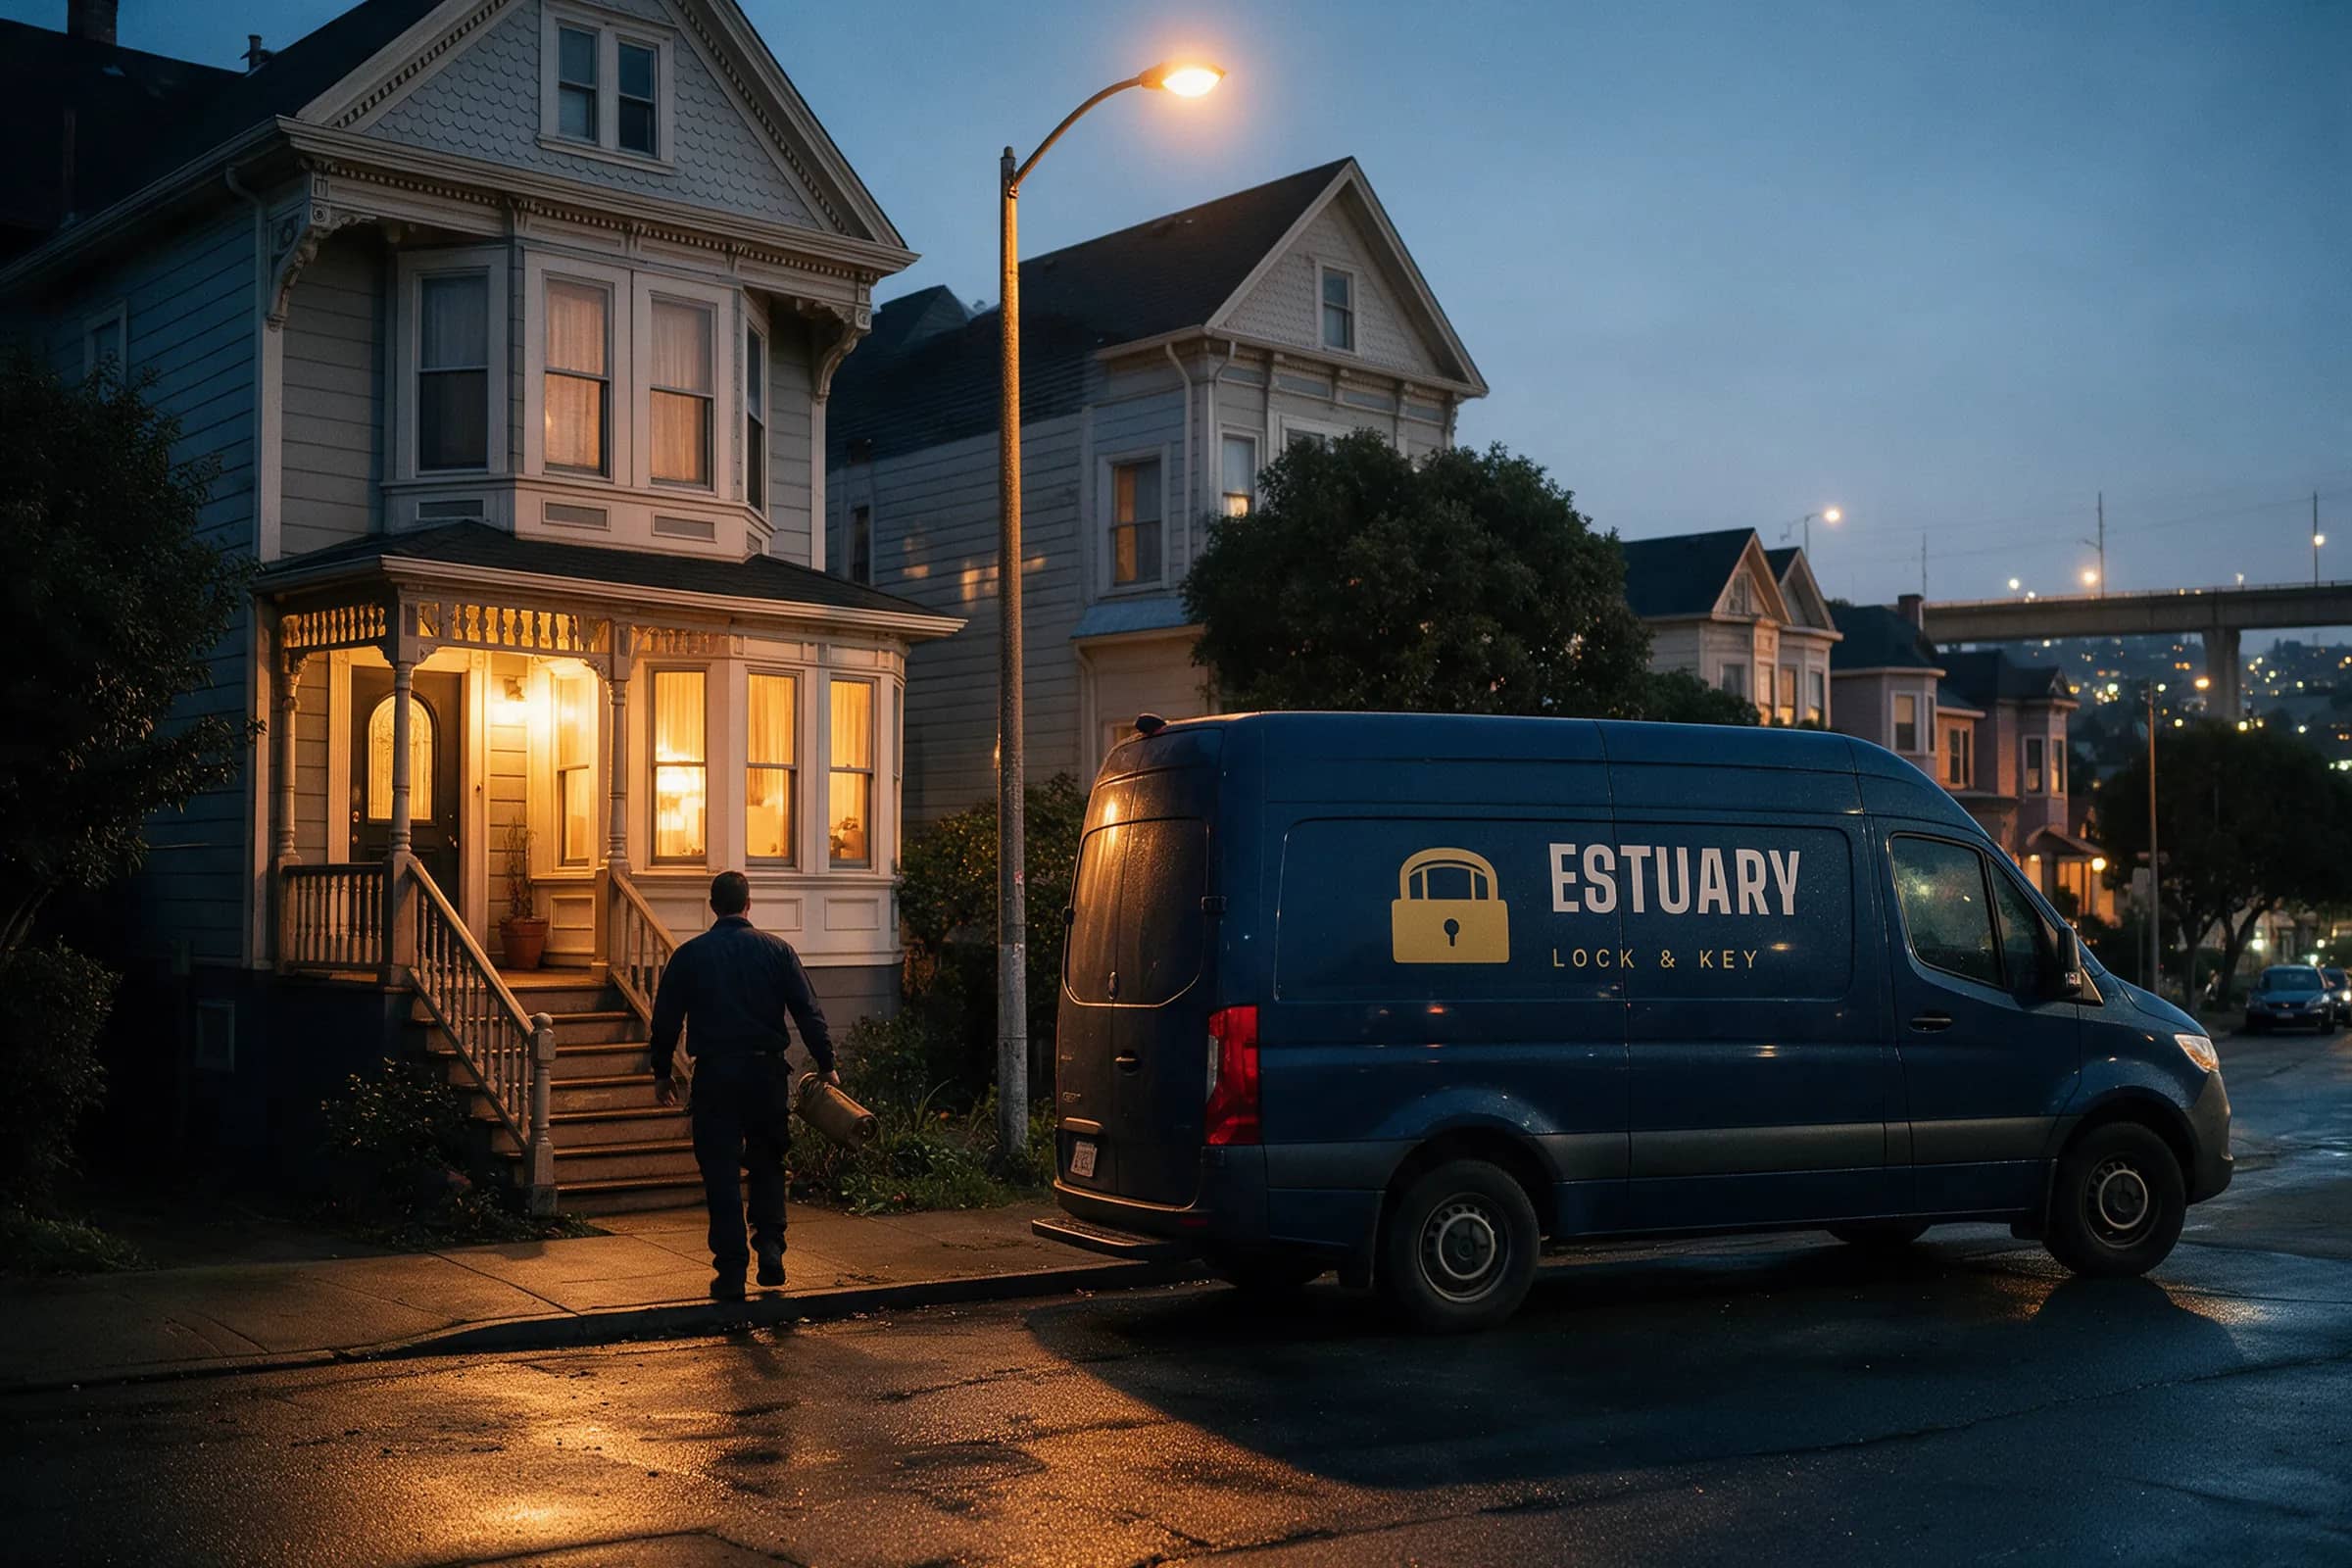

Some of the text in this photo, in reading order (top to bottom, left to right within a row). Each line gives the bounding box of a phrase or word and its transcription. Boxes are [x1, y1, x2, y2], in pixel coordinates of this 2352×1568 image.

[1549, 843, 1800, 915] ESTUARY
[1552, 949, 1757, 968] LOCK & KEY
